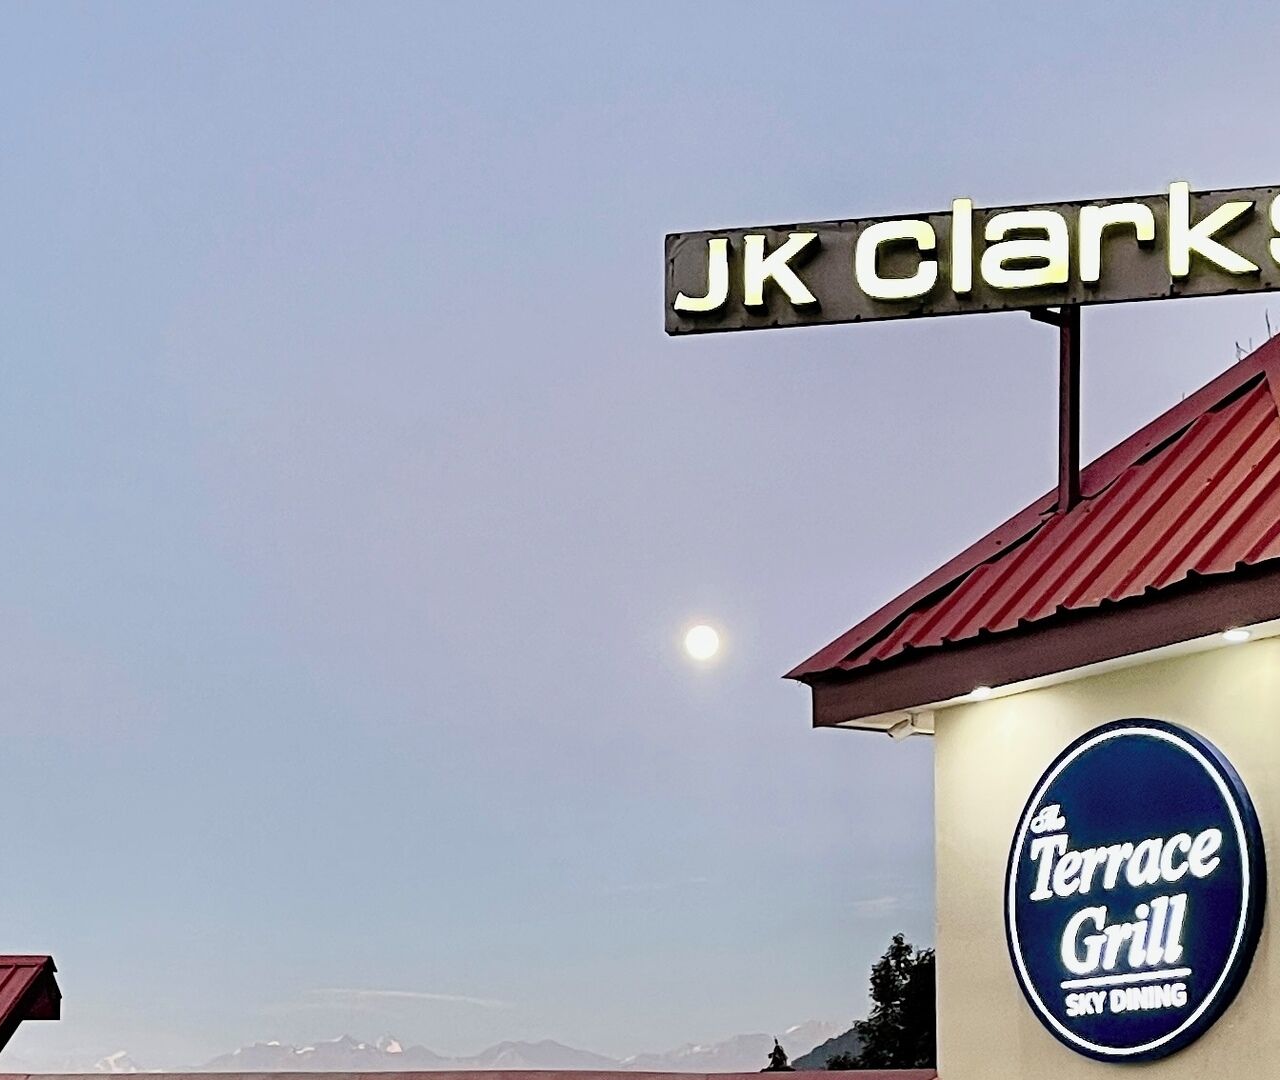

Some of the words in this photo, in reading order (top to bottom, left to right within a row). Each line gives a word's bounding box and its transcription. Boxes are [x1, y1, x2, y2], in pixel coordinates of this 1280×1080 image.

[674, 232, 818, 313] JK
[1030, 828, 1222, 901] Terrace
[1061, 893, 1187, 974] Grill
[1065, 991, 1107, 1017] SKY
[1110, 982, 1187, 1014] DINING
